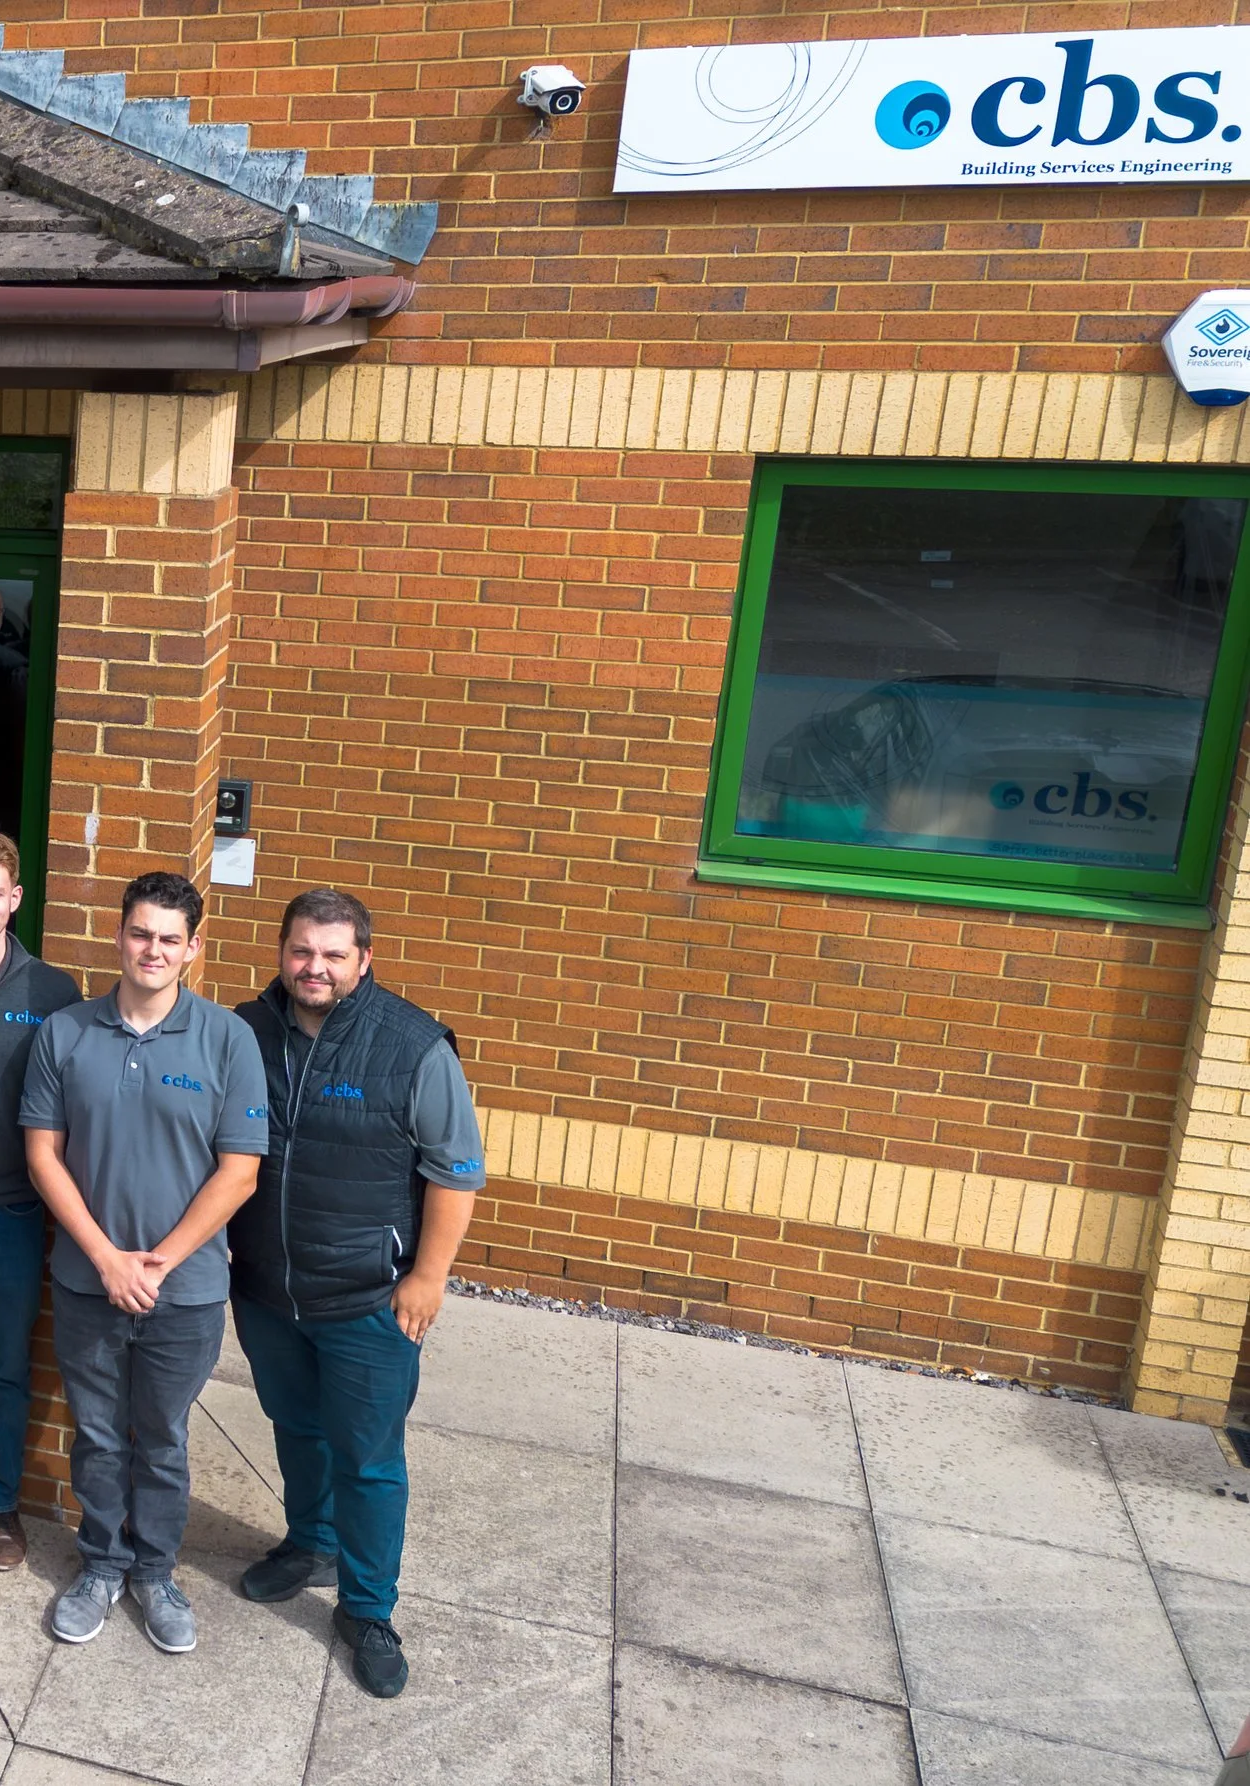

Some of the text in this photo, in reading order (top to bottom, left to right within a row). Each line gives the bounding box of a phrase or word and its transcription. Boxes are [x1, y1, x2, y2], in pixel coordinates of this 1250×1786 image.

[970, 38, 1242, 148] cbs.
[961, 158, 1233, 177] Building Services Engineering
[1033, 771, 1158, 822] cbs.
